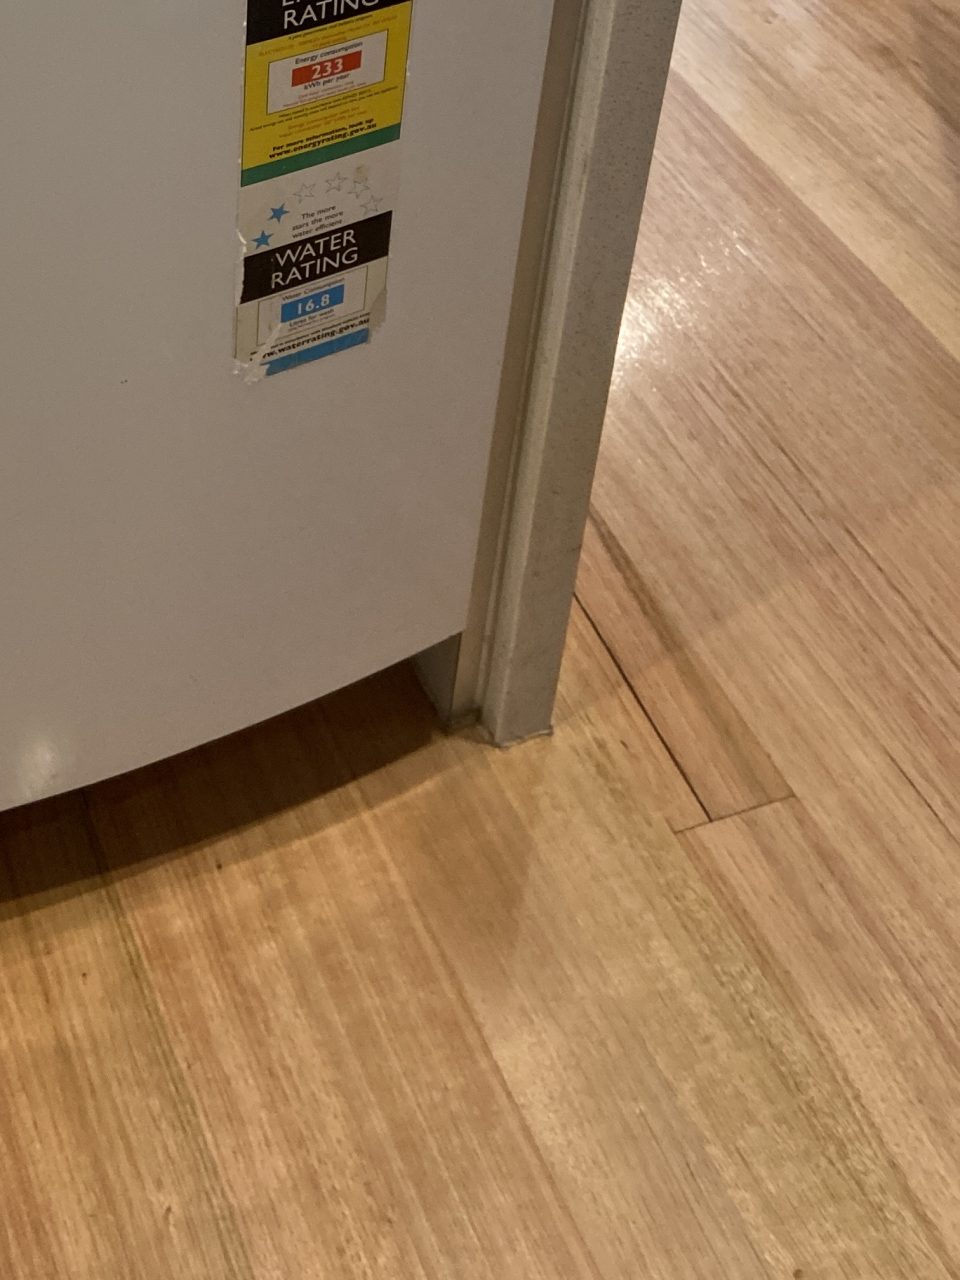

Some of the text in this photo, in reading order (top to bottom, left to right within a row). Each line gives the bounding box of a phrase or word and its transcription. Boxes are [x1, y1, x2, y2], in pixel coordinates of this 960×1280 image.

[295, 52, 319, 66] Energy
[311, 58, 344, 80] 233
[301, 205, 337, 220] The more
[324, 210, 344, 222] more
[275, 229, 357, 267] WATER
[271, 246, 359, 289] RATING
[297, 294, 330, 315] 16.8
